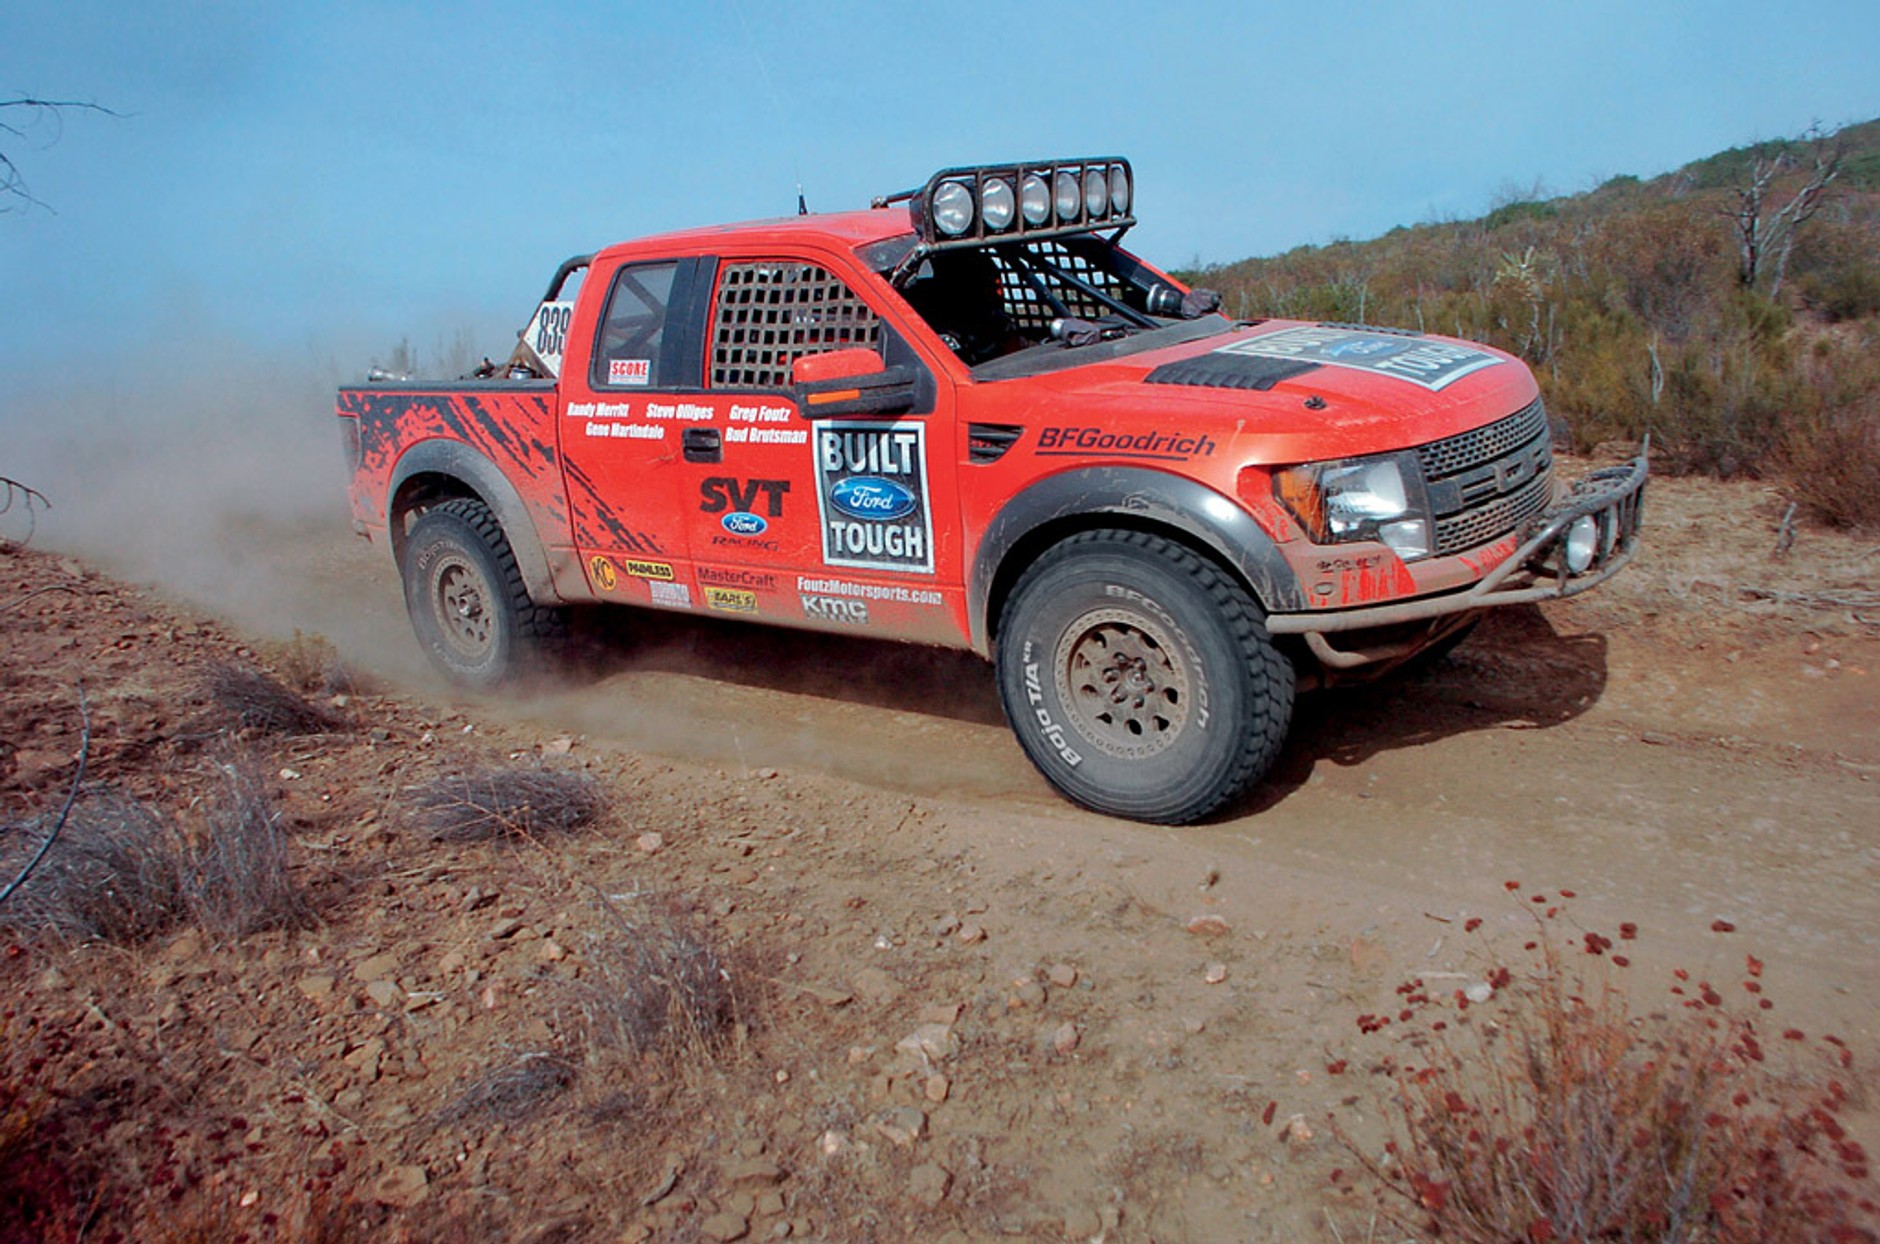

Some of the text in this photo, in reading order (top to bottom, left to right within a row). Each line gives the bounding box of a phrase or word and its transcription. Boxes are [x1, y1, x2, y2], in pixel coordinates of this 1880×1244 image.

[611, 362, 647, 375] SCORE
[729, 405, 791, 422] Greg Foutz
[586, 422, 610, 436] Gene
[725, 427, 807, 444] Bud Brutsman
[1038, 428, 1216, 456] BFGoodrich
[822, 432, 916, 473] BUILT
[700, 477, 790, 517] SVT
[849, 486, 894, 510] Ford
[730, 515, 758, 531] Ford
[712, 535, 779, 551] RACING
[830, 522, 923, 558] TOUGH
[592, 557, 614, 588] KC
[699, 567, 775, 588] MasterCraft
[797, 576, 942, 605] FoutzMotorsports.com
[1105, 585, 1209, 728] BFGoodrich
[1025, 662, 1042, 706] T/A
[1036, 707, 1082, 767] Baja
